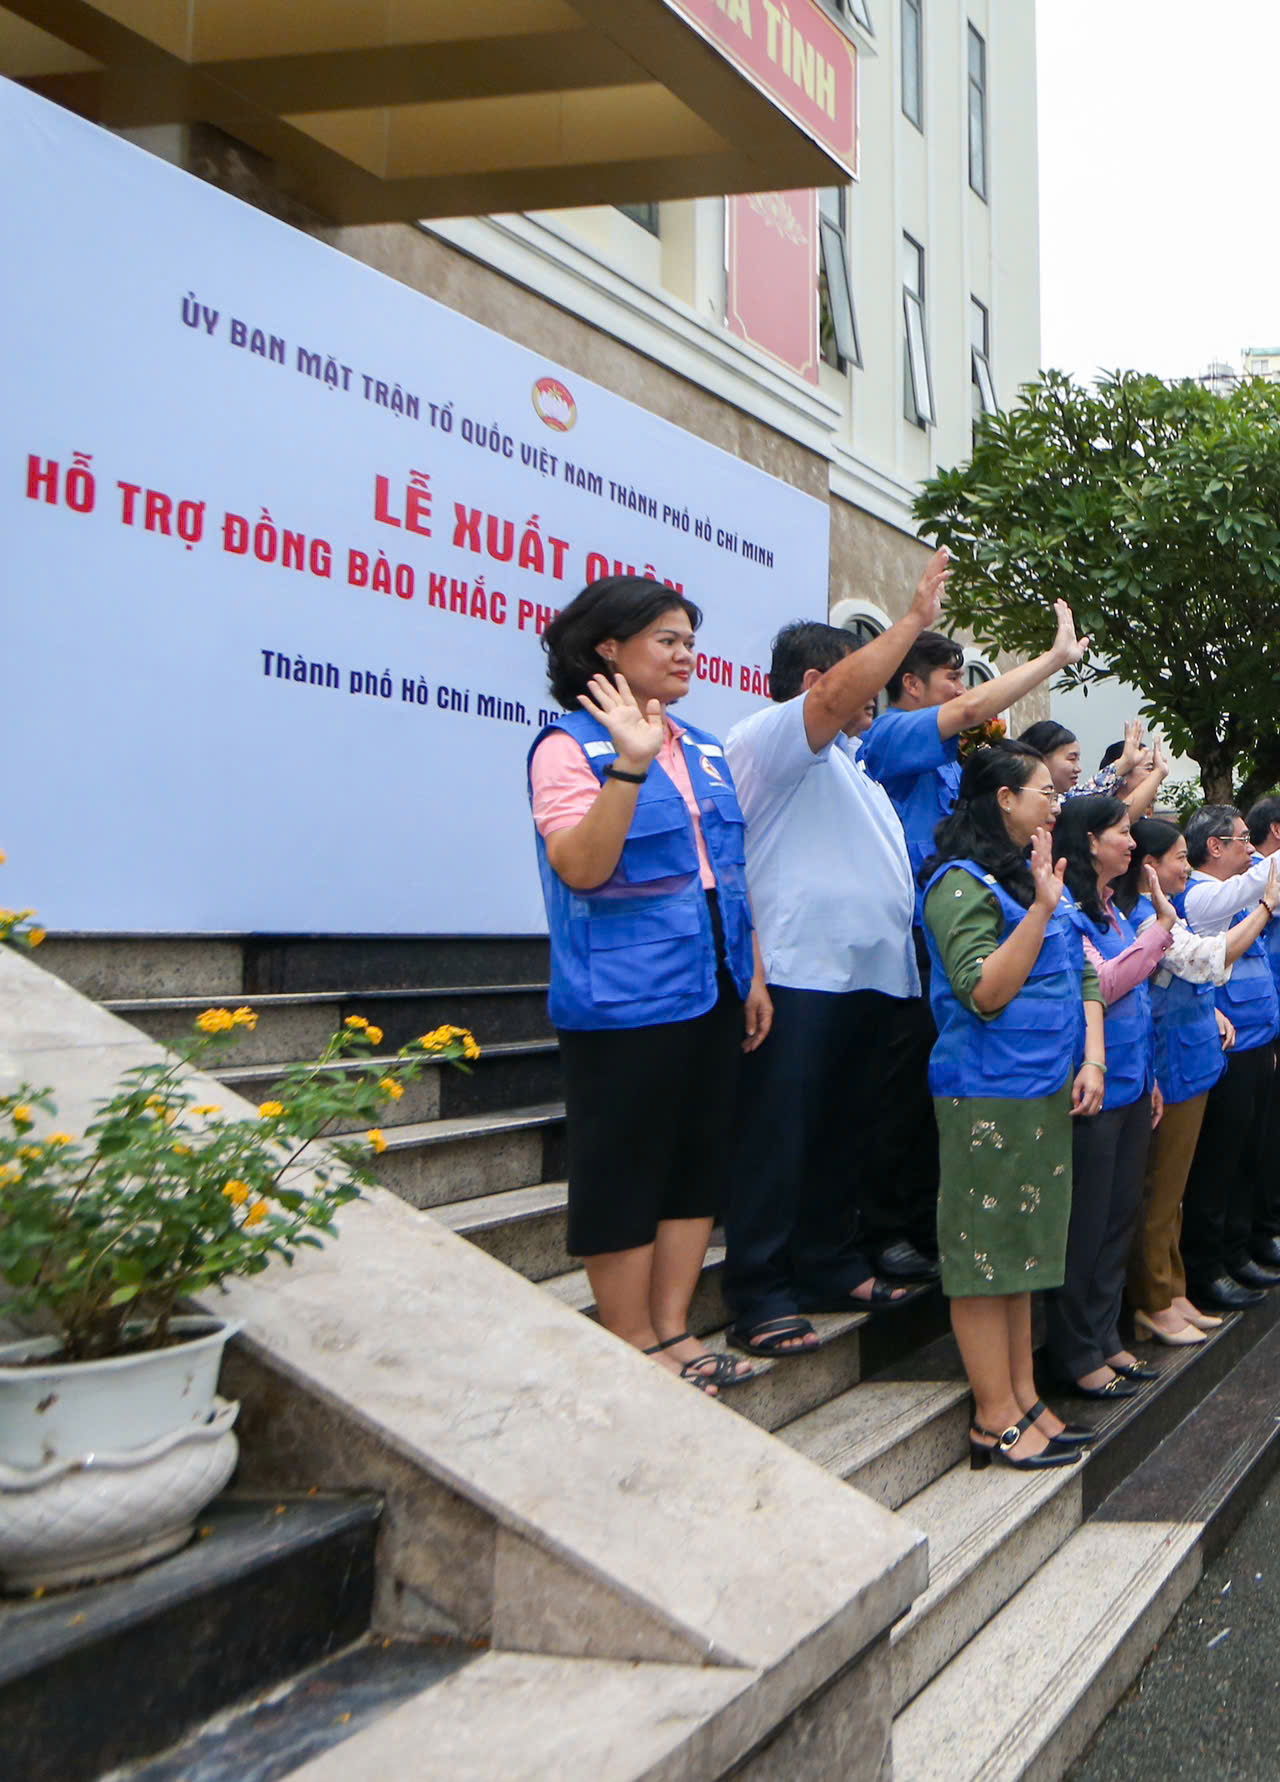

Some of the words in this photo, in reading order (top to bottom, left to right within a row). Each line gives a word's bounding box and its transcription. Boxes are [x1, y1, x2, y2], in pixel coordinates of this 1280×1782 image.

[762, 0, 836, 121] TÌNH
[182, 291, 219, 335] ỦY
[231, 318, 286, 364] BAN
[298, 345, 353, 391] MẶT
[361, 374, 420, 421] TRẬN
[428, 401, 455, 432] TỔ
[461, 419, 515, 458] QUỐC
[520, 442, 558, 478] VIỆT
[564, 462, 604, 497] NAM
[609, 481, 658, 519] THÀNH
[663, 505, 691, 533] PHỐ
[695, 517, 713, 542] HỒ
[717, 531, 739, 554] CHÍ
[742, 541, 775, 569] MINH
[25, 451, 97, 515] HỖ
[116, 481, 206, 551] TRỢ
[221, 507, 333, 579] ĐỒNG
[347, 549, 416, 601] BÀO
[428, 573, 508, 625] KHẮC
[518, 599, 557, 637] PH
[696, 652, 733, 688] CƠN
[374, 468, 433, 538] LỄ
[452, 502, 570, 580] XUẤT
[261, 649, 340, 689] Thành
[349, 668, 393, 699] phố
[401, 675, 428, 705] Hồ
[436, 685, 470, 713] Chí
